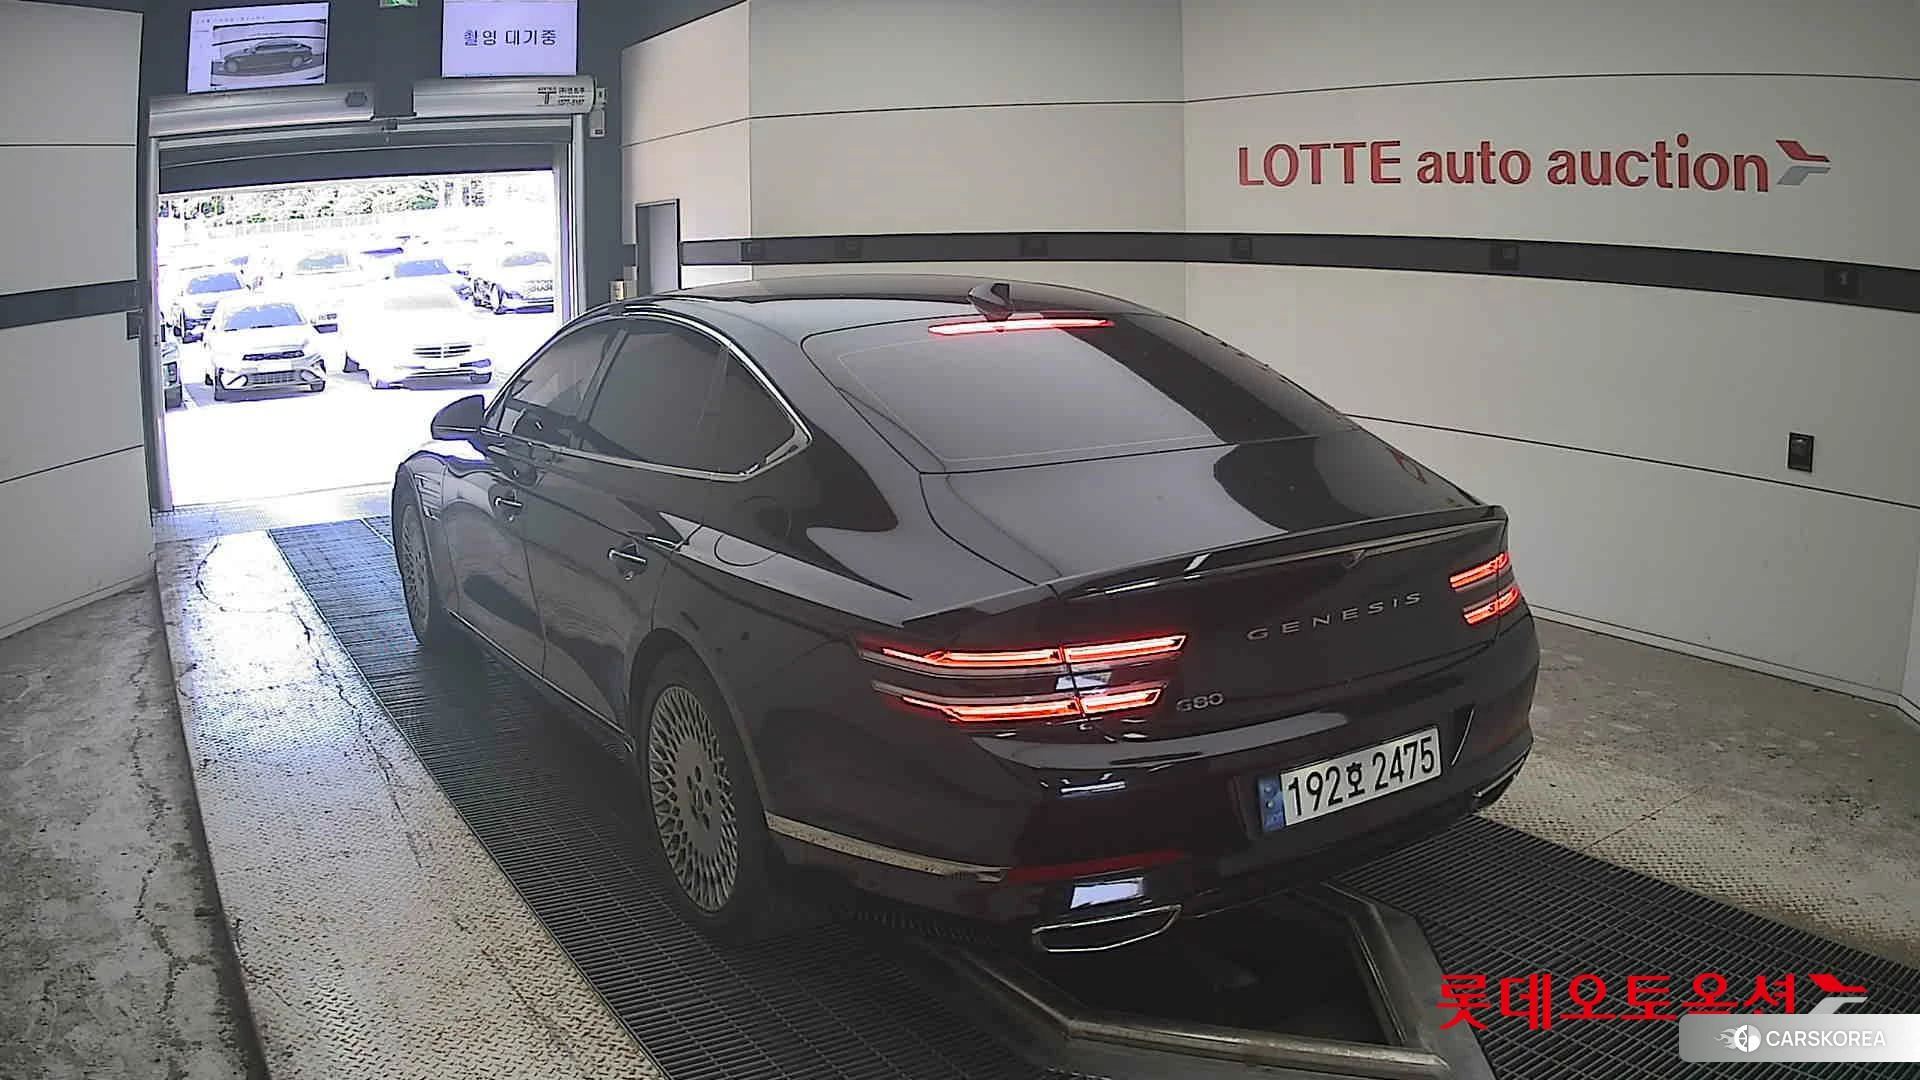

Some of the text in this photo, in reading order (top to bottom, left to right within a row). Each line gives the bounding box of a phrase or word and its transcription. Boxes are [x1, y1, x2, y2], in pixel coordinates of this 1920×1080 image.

[505, 29, 557, 46] 대기중
[1238, 133, 1769, 192] LOTTE auto auction
[1247, 592, 1422, 641] GENESIS
[1175, 692, 1224, 712] G80
[1288, 736, 1435, 817] 192호 2475
